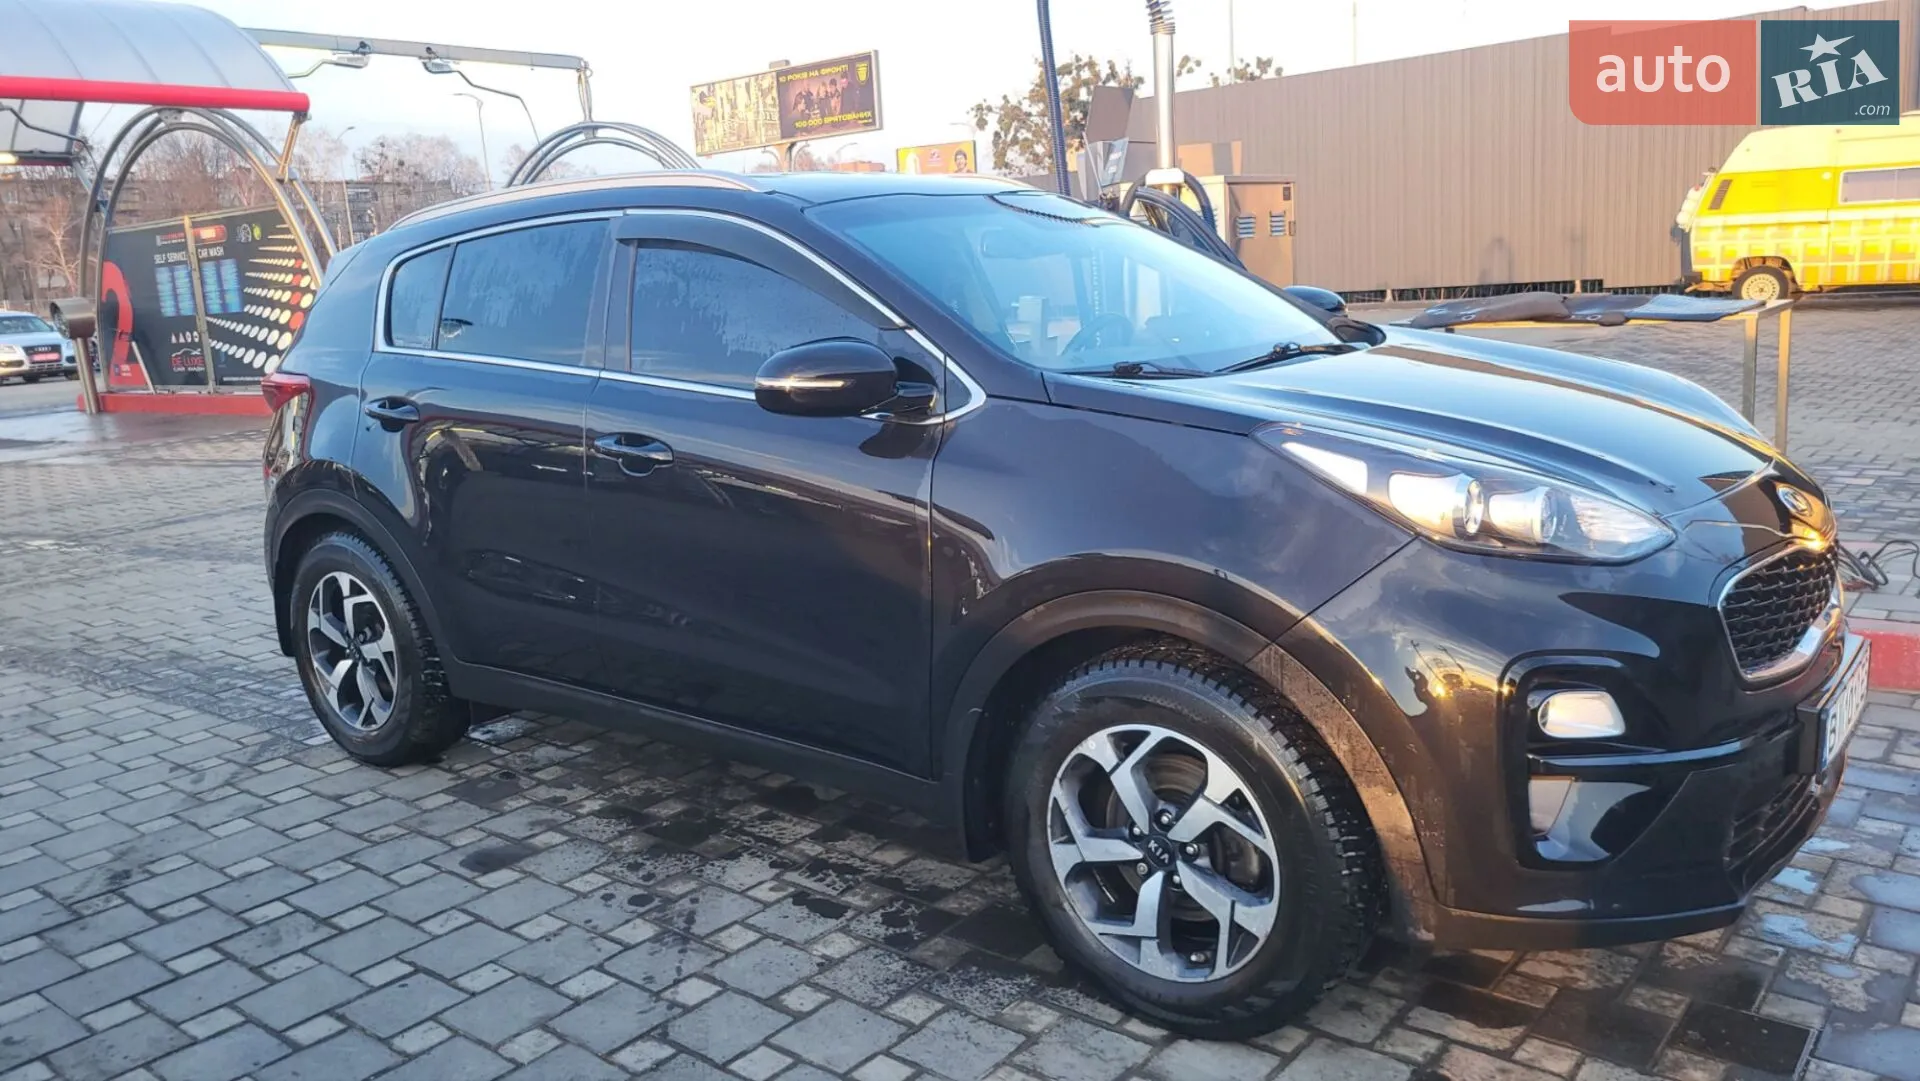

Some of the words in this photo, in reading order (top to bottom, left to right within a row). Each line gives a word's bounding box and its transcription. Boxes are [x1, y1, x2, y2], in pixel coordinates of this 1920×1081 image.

[154, 253, 166, 264] SELF
[167, 251, 188, 262] SERVICE
[197, 247, 208, 259] CAR
[208, 246, 225, 258] WASH
[1148, 839, 1169, 864] KIA
